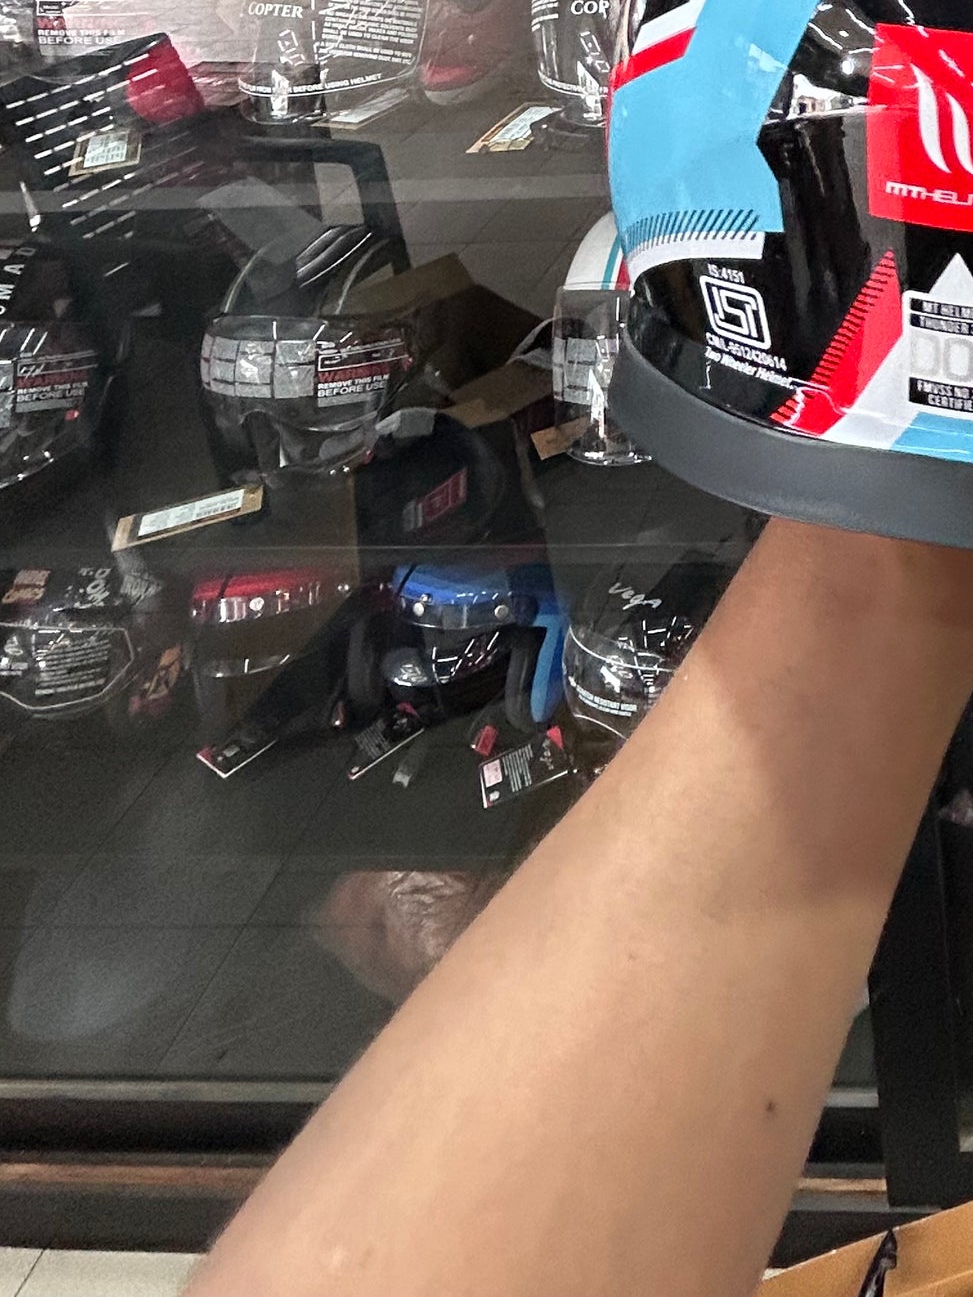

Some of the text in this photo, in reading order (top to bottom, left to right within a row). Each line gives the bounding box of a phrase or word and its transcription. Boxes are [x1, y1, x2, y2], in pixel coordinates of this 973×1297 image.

[248, 1, 304, 19] COPTER
[571, 0, 610, 16] COP
[38, 36, 92, 45] BEFORE
[922, 301, 940, 313] MT
[919, 315, 970, 336] THUNDER
[705, 346, 721, 363] Two
[720, 353, 757, 376] Wheeler
[318, 380, 353, 390] REMOVE
[318, 382, 386, 398] BEFORE USE
[16, 388, 85, 403] BEFORE USE
